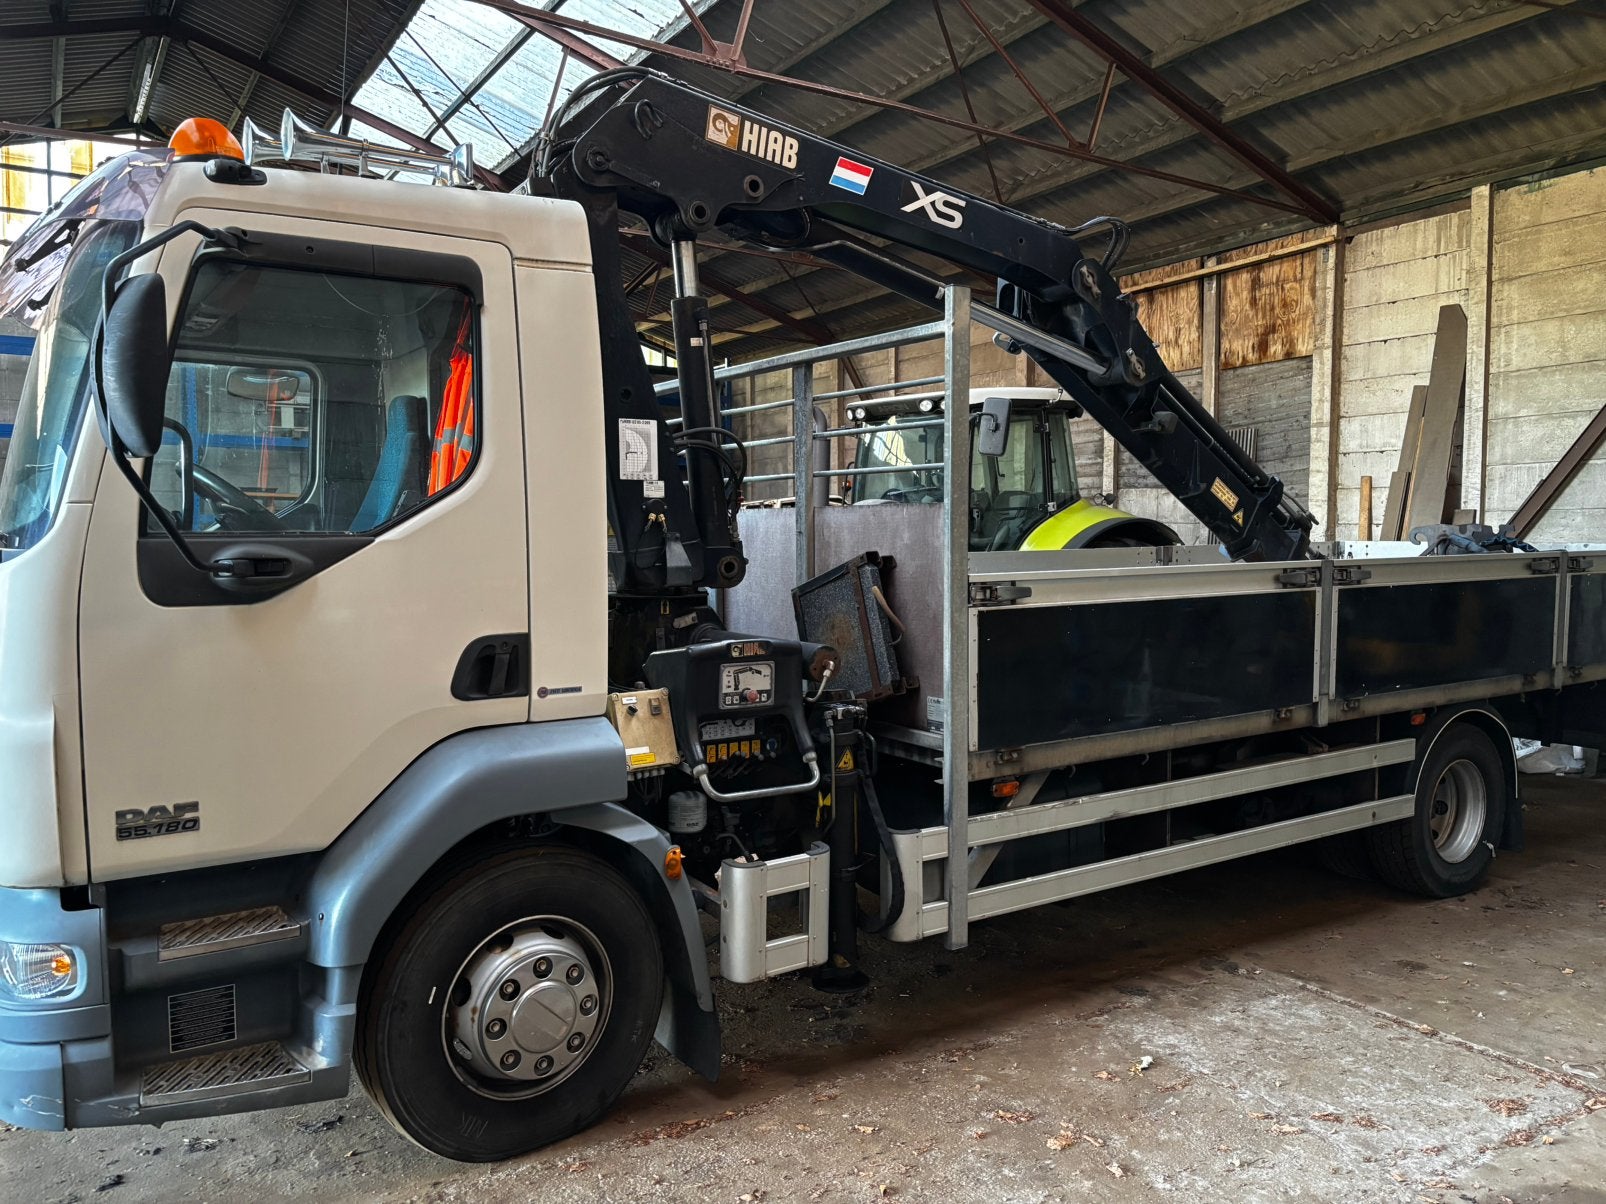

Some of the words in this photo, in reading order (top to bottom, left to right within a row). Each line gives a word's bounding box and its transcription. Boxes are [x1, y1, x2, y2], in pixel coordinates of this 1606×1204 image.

[741, 120, 799, 169] HIAB
[900, 180, 967, 229] XS
[115, 801, 199, 825] DAF
[118, 818, 198, 838] 55.180
